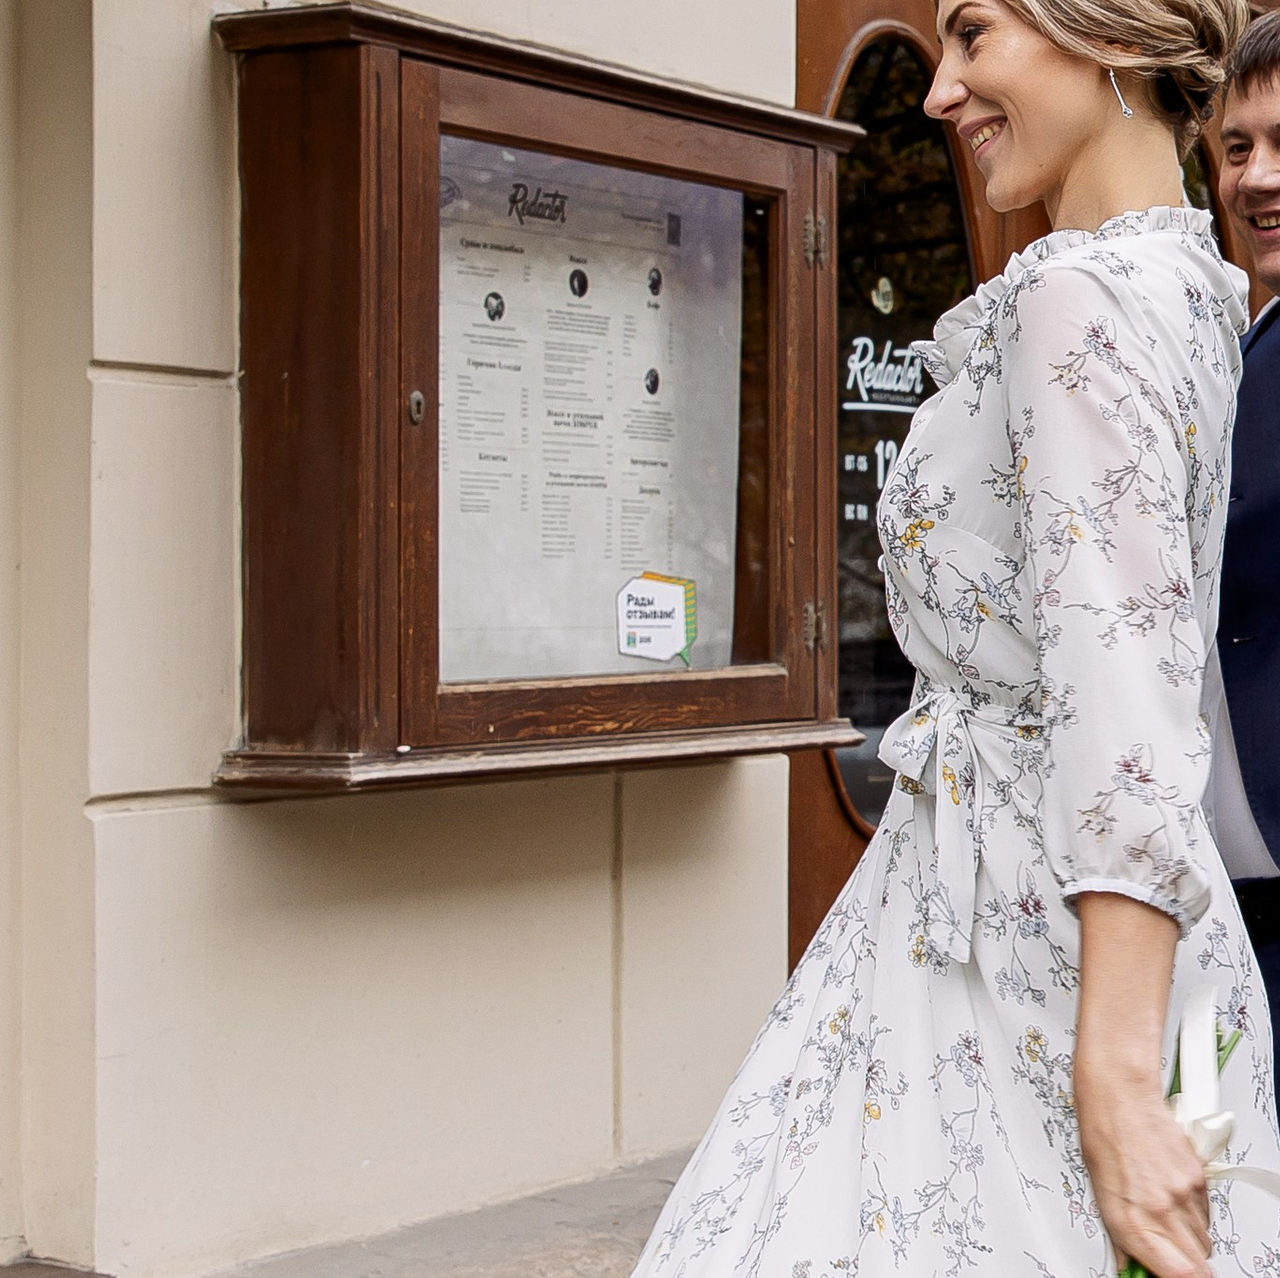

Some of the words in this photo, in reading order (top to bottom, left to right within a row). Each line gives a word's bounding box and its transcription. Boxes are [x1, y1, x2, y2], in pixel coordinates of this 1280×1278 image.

[508, 182, 569, 226] Redactor
[846, 336, 925, 402] Redactor
[627, 593, 655, 607] Рады
